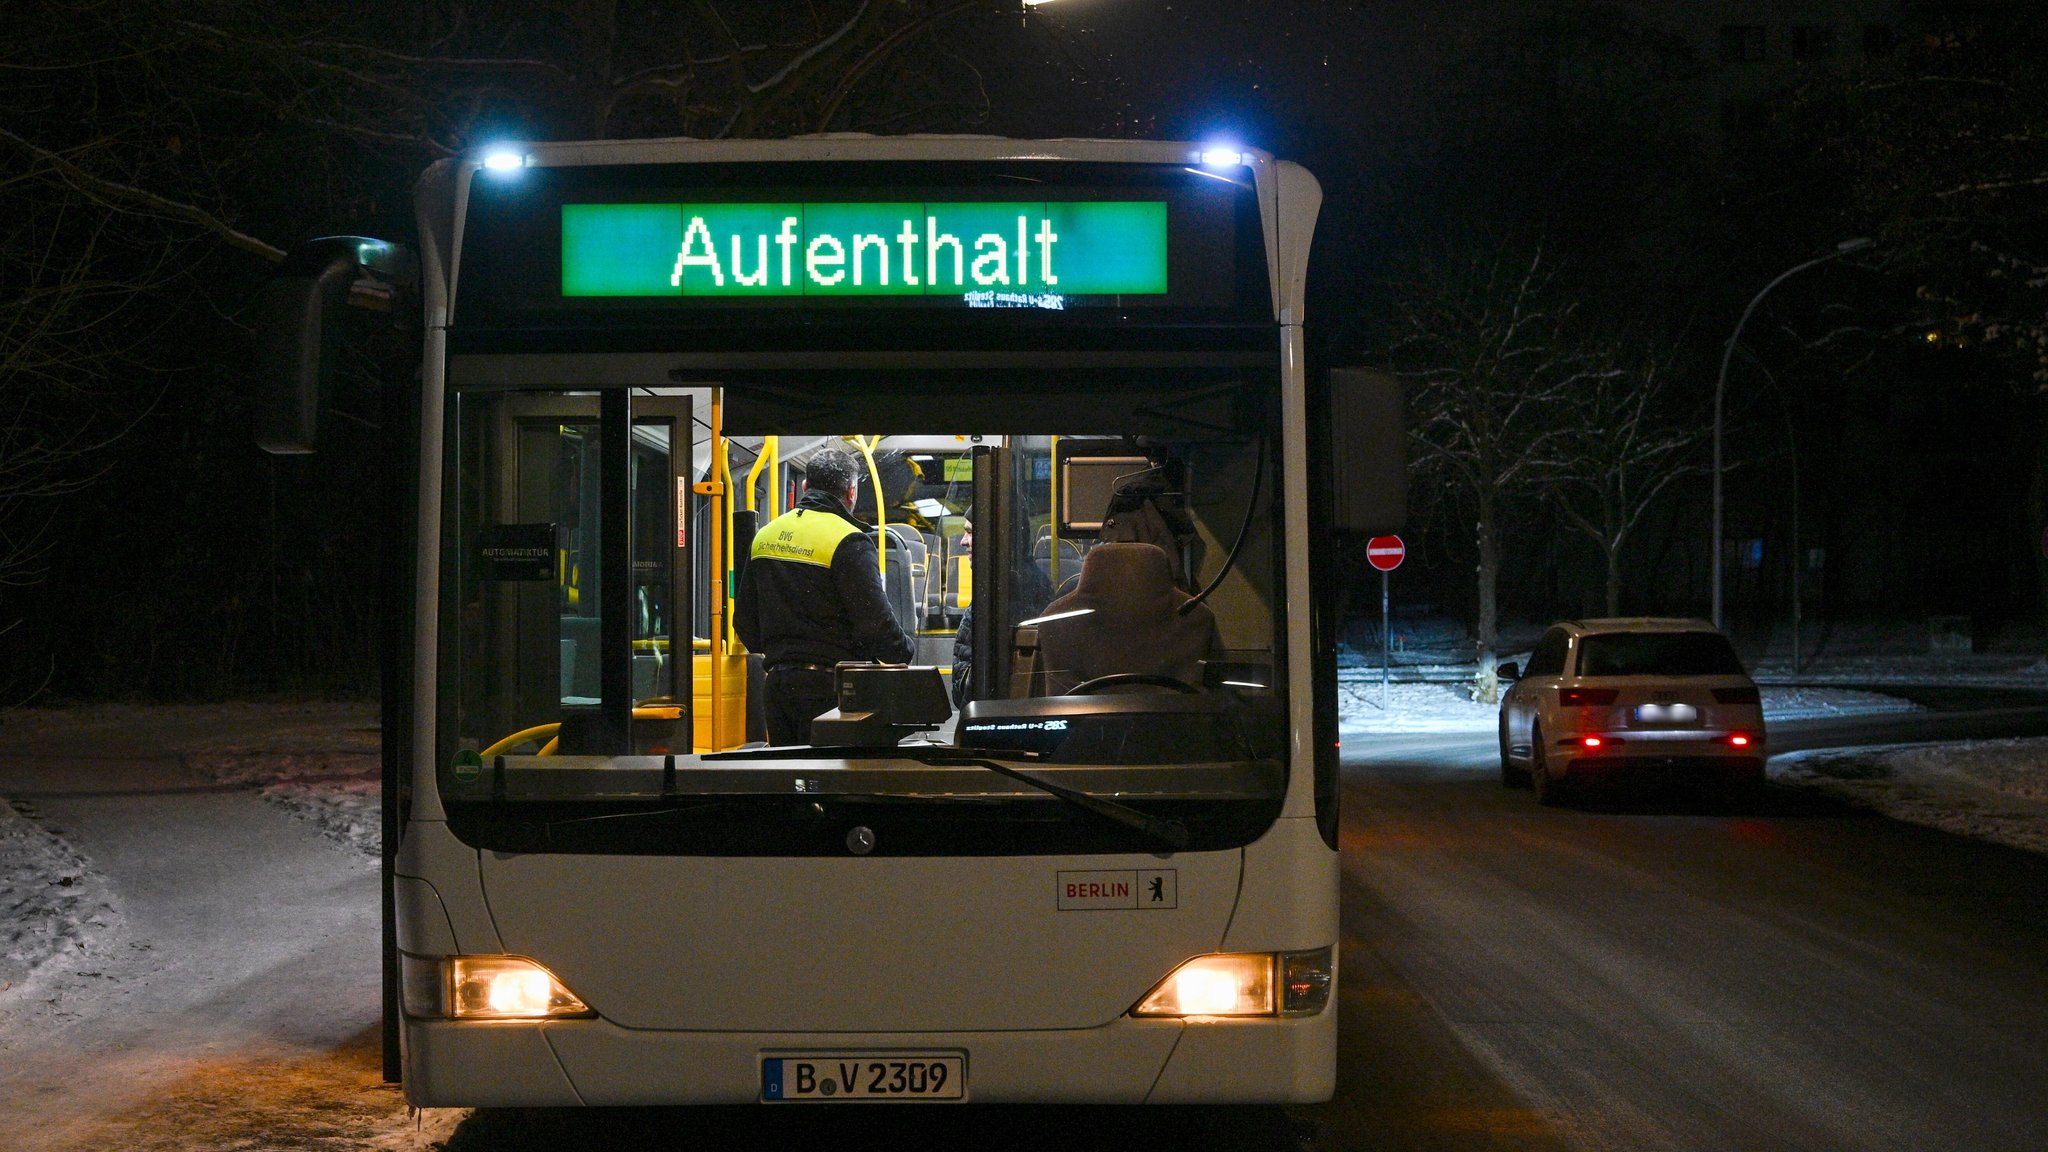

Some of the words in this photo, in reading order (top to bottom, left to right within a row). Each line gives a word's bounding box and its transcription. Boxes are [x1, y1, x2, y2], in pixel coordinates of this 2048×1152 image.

[670, 214, 1058, 288] Aufenthalt
[778, 530, 794, 541] BVG
[758, 542, 814, 556] Sicherheitsdienst
[1066, 882, 1129, 898] BERLIN
[797, 1063, 816, 1094] B
[839, 1063, 859, 1093] V
[868, 1063, 948, 1093] 2309
[770, 1083, 778, 1093] D
